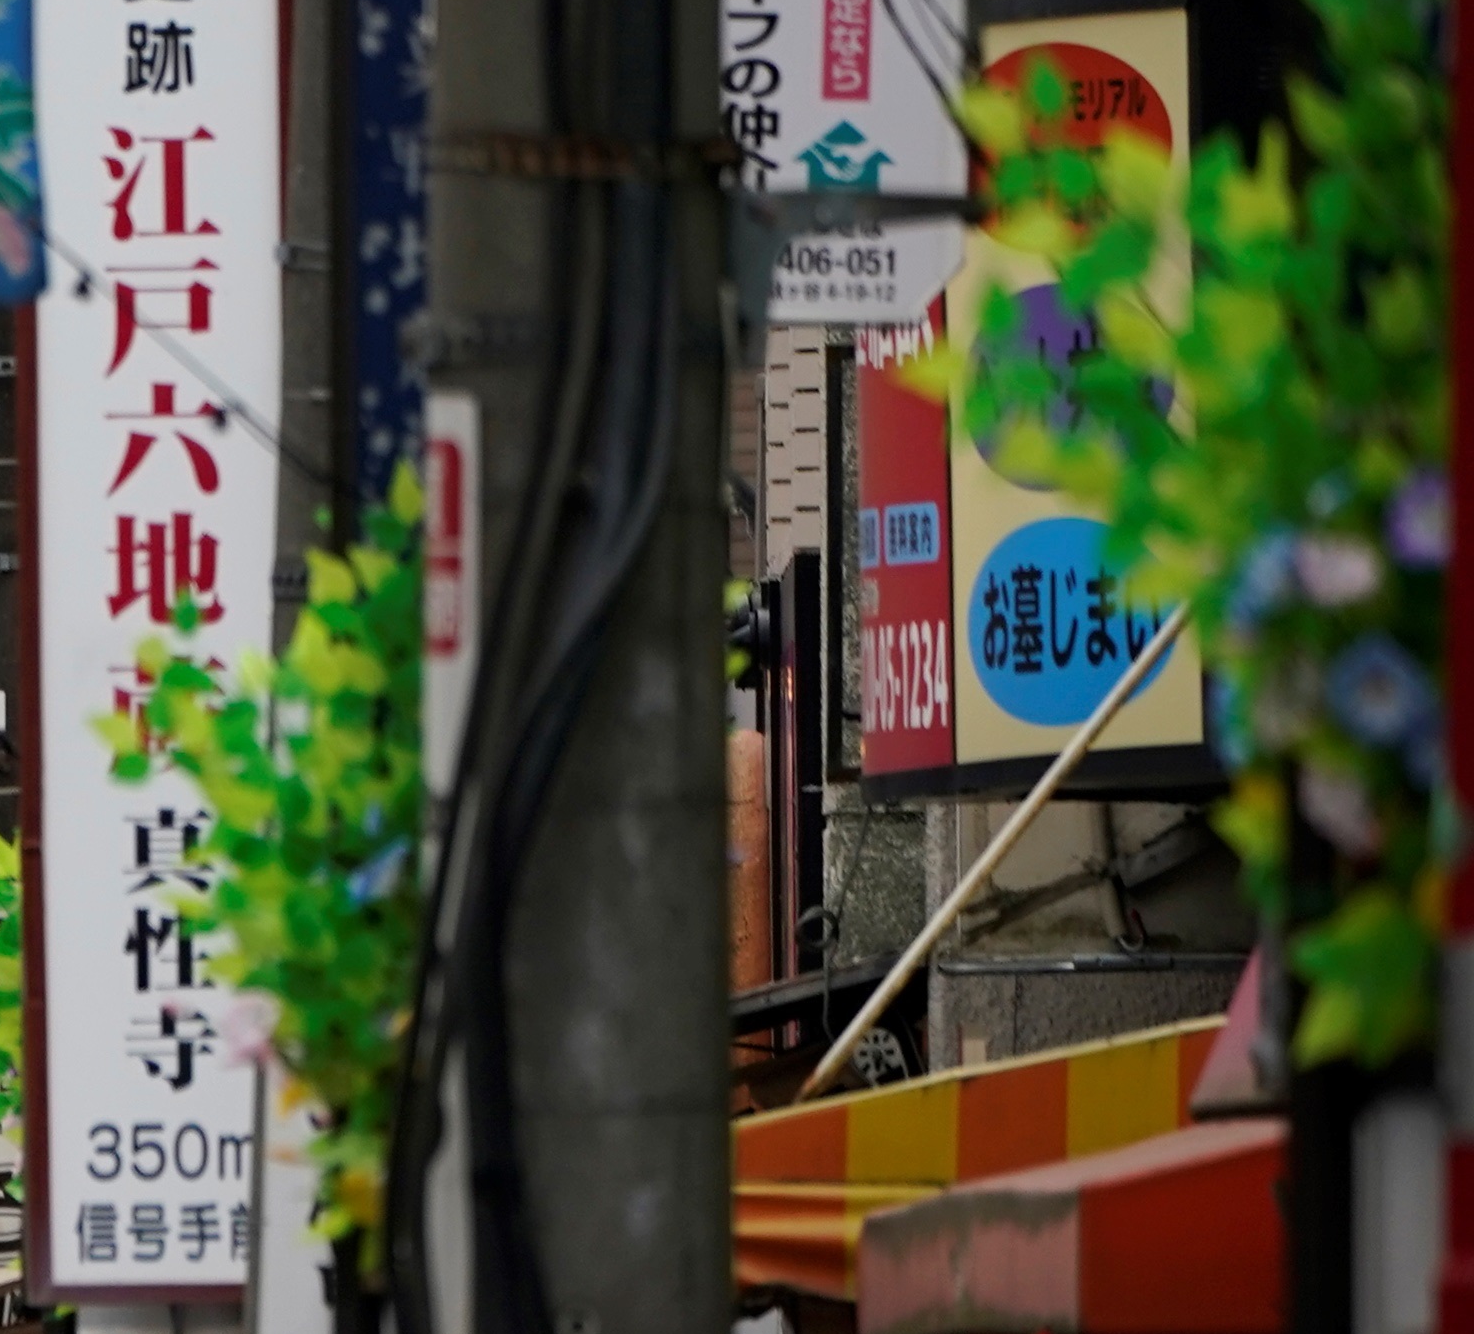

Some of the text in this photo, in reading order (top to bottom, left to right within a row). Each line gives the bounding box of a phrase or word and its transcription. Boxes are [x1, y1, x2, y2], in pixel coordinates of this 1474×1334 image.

[122, 807, 218, 1091] 真性寺
[87, 1122, 254, 1183] 350m
